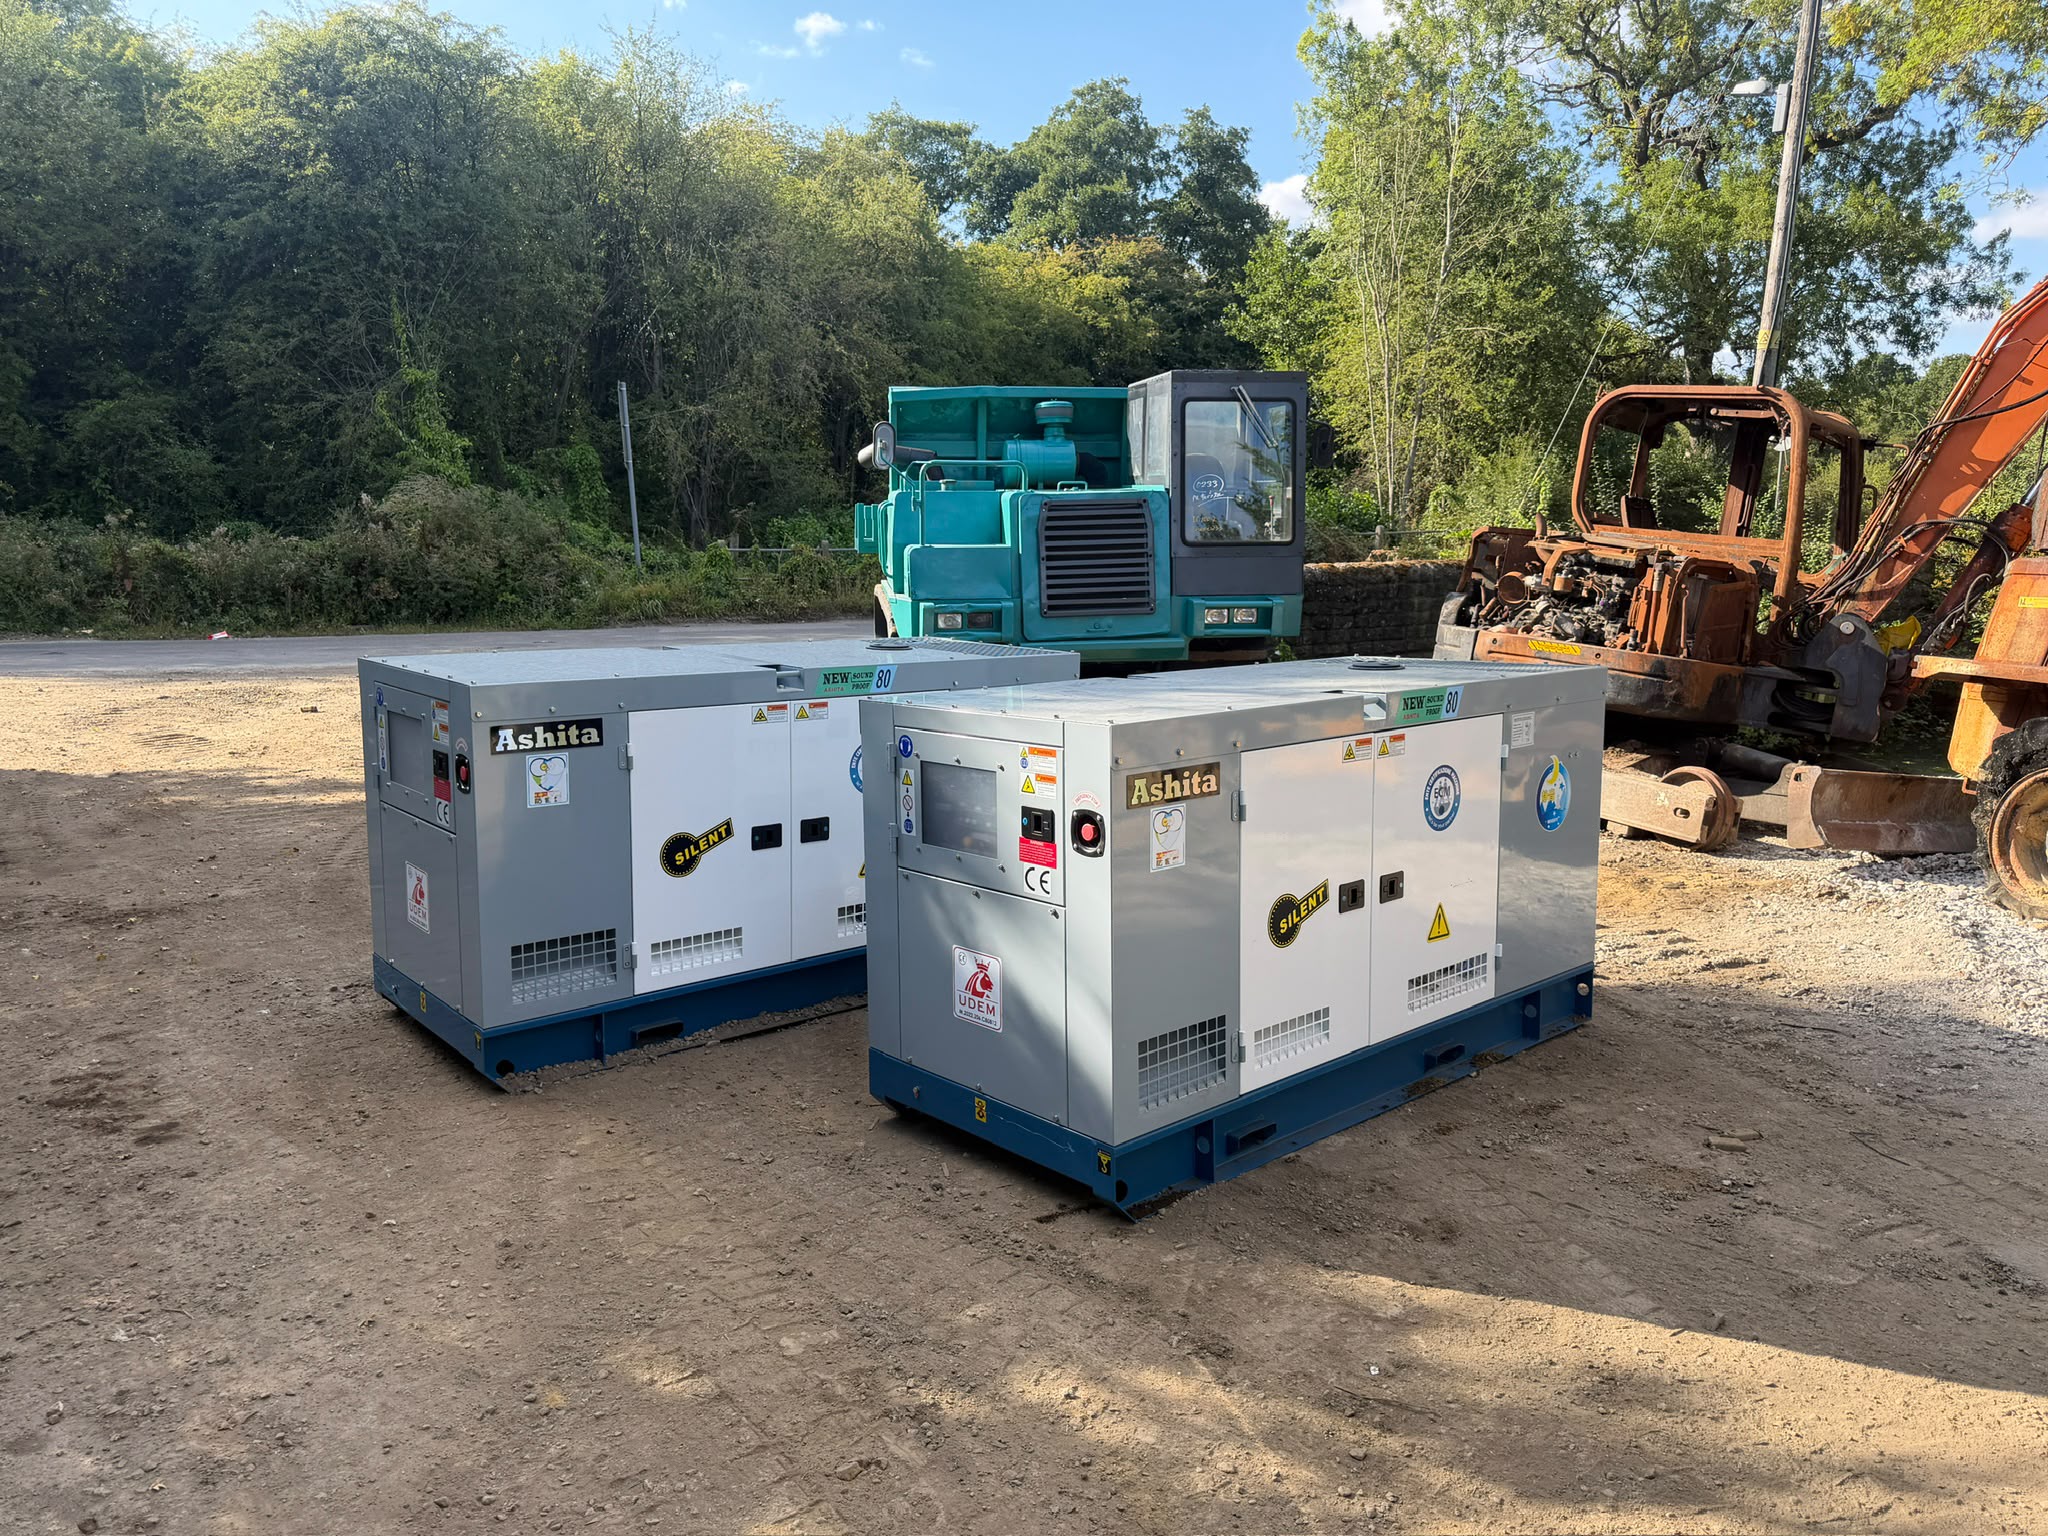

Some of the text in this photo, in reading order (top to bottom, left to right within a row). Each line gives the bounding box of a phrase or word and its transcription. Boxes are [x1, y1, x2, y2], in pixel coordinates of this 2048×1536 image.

[823, 672, 851, 685] NEW
[876, 669, 891, 688] 80
[1402, 695, 1426, 711] NEW
[1445, 690, 1458, 713] 80
[495, 724, 600, 752] Ashita
[1131, 770, 1218, 805] Ashita
[674, 825, 728, 865] SILENT
[1024, 866, 1051, 895] CE
[1279, 886, 1325, 934] SILENT
[958, 994, 996, 1017] UDEM
